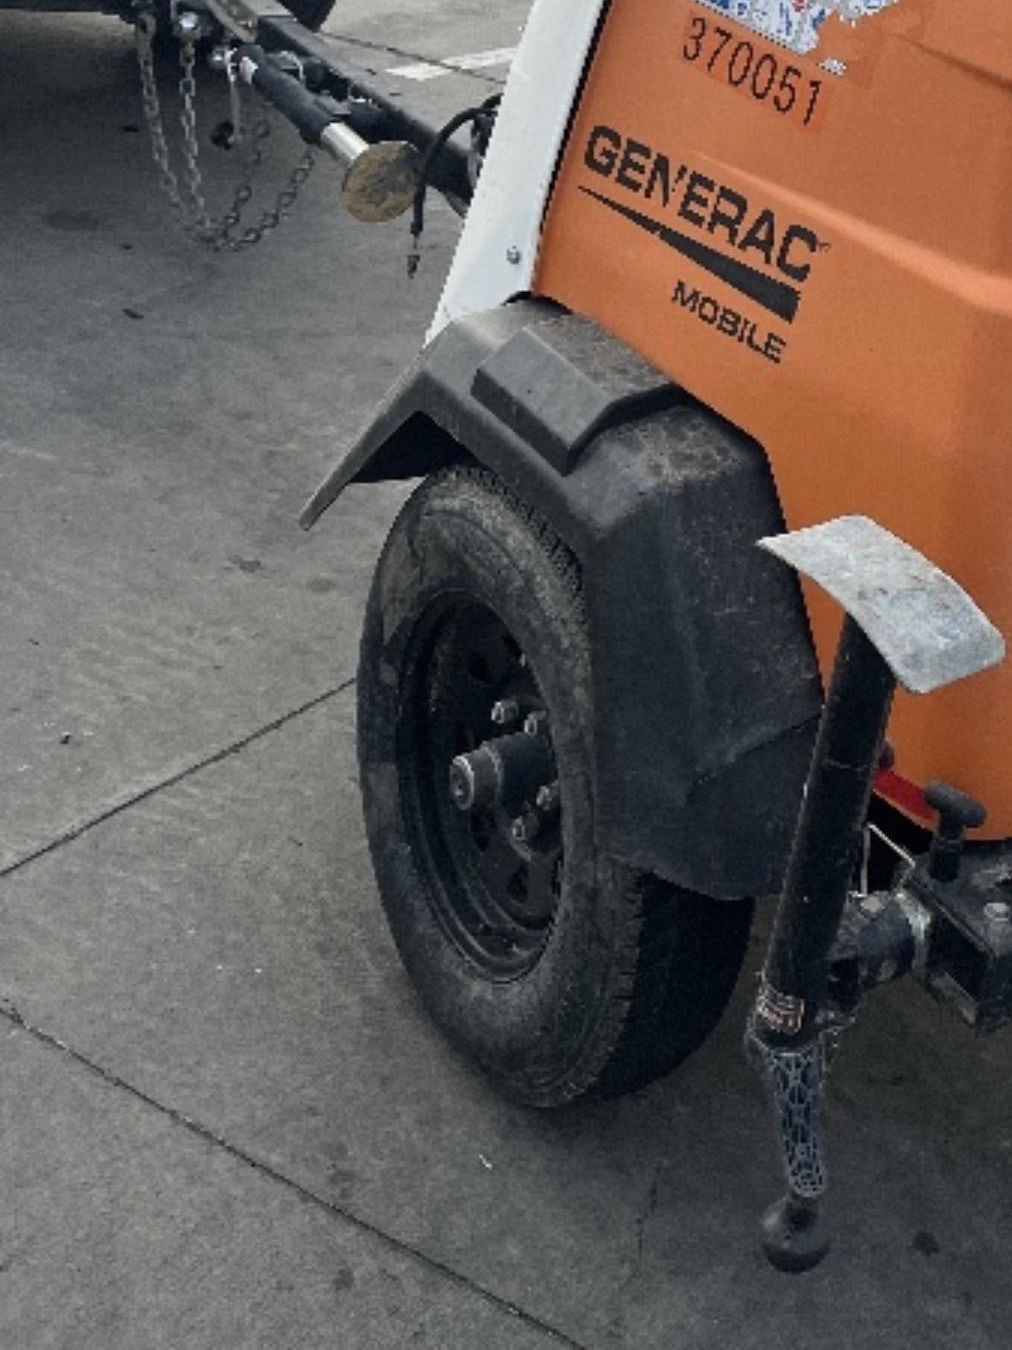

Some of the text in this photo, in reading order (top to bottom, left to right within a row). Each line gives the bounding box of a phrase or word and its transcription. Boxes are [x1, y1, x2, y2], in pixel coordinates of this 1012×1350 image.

[683, 17, 822, 125] 370051
[584, 125, 818, 282] GENERAC
[671, 280, 786, 363] MOBILE
